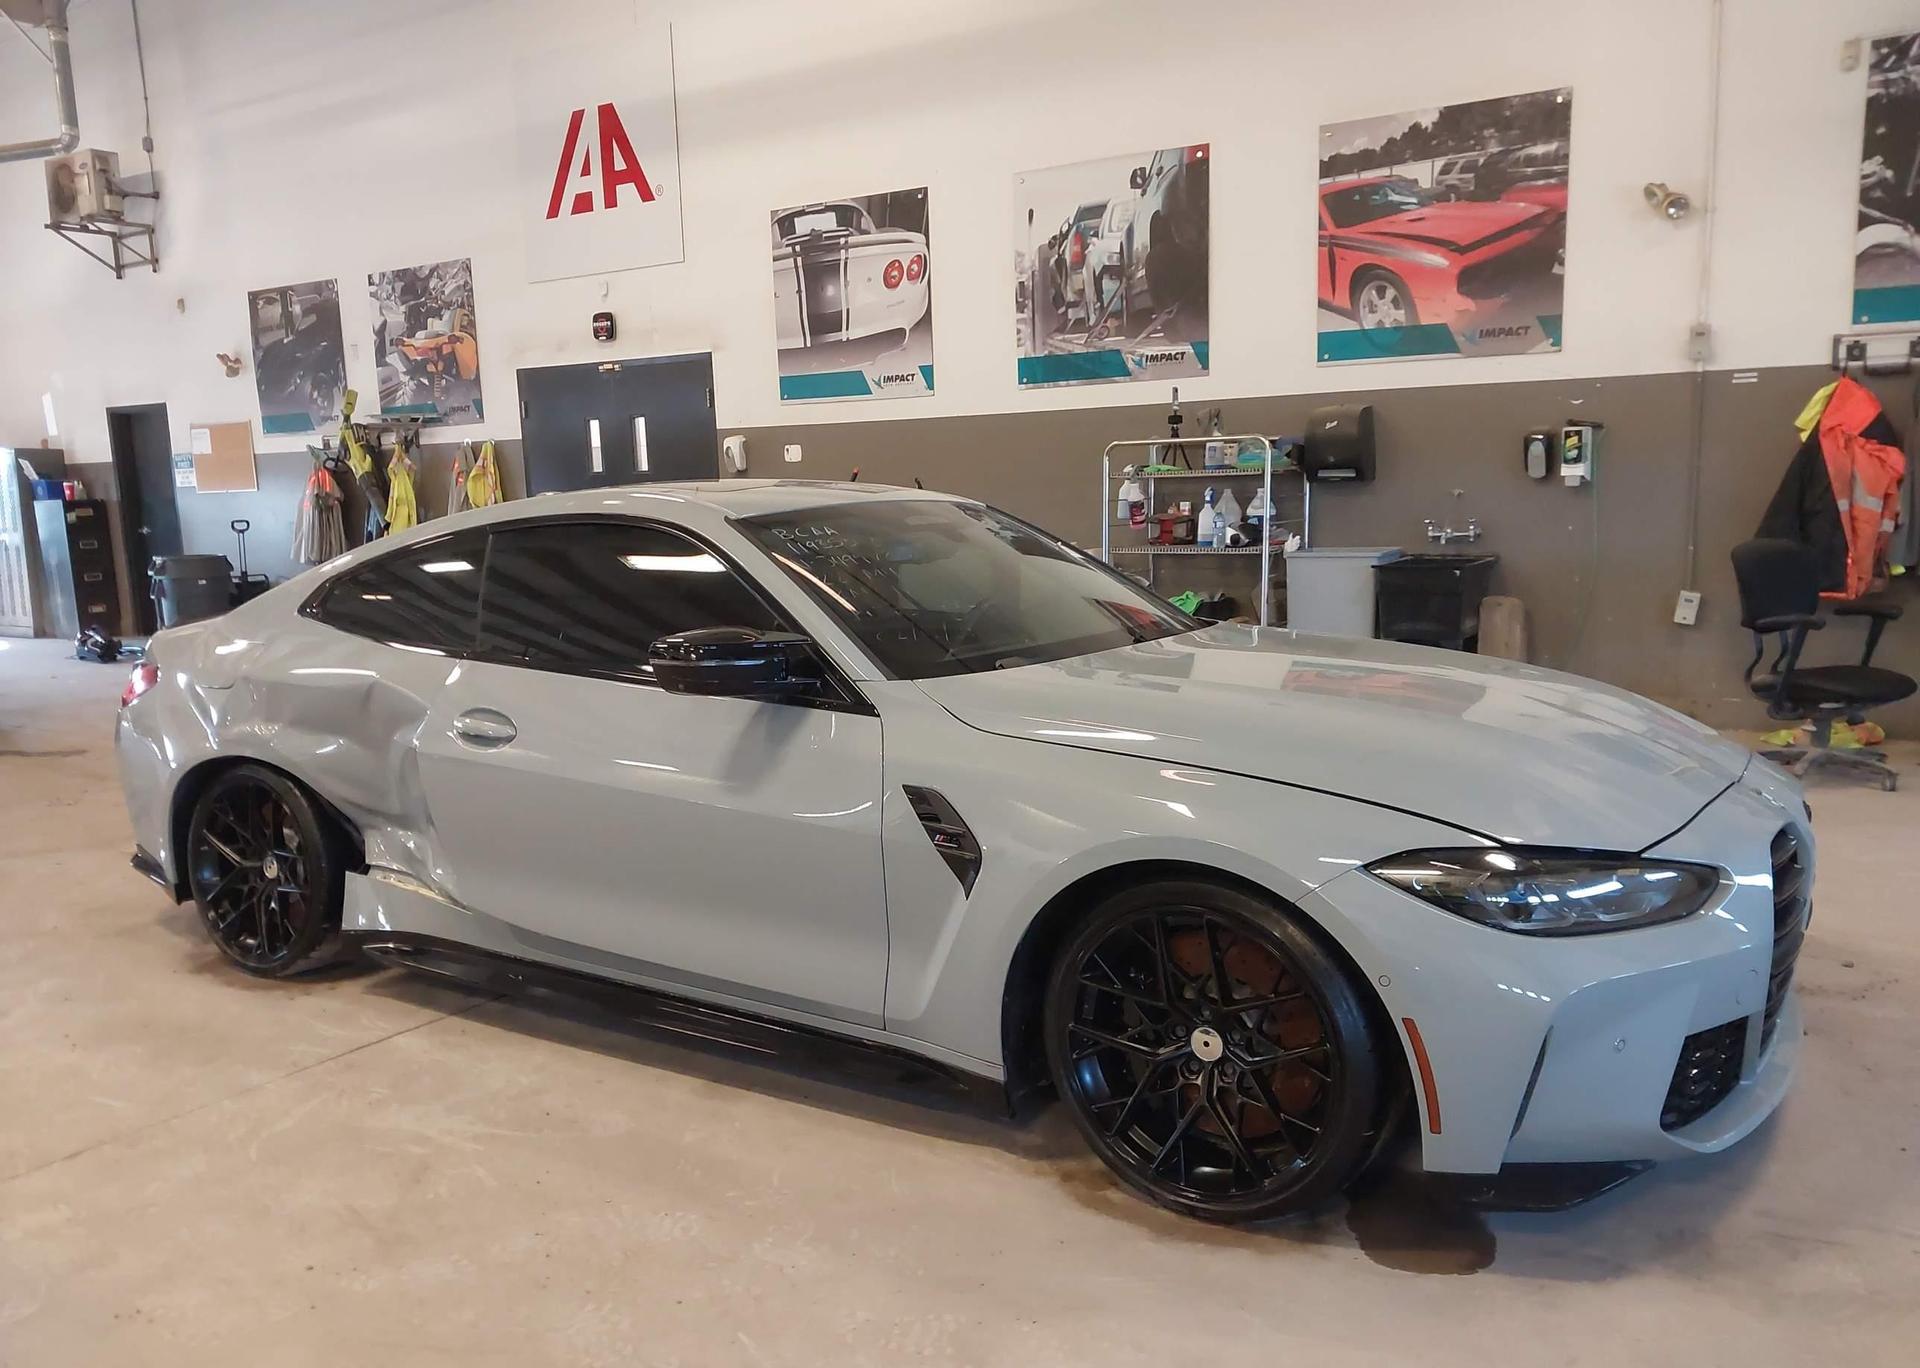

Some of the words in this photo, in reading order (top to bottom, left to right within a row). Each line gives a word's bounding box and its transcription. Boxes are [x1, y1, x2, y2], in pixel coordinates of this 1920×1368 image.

[1478, 326, 1531, 339] IMPACT
[1145, 351, 1186, 364] IMPACT
[882, 373, 916, 384] IMPACT
[771, 525, 840, 541] BCAA
